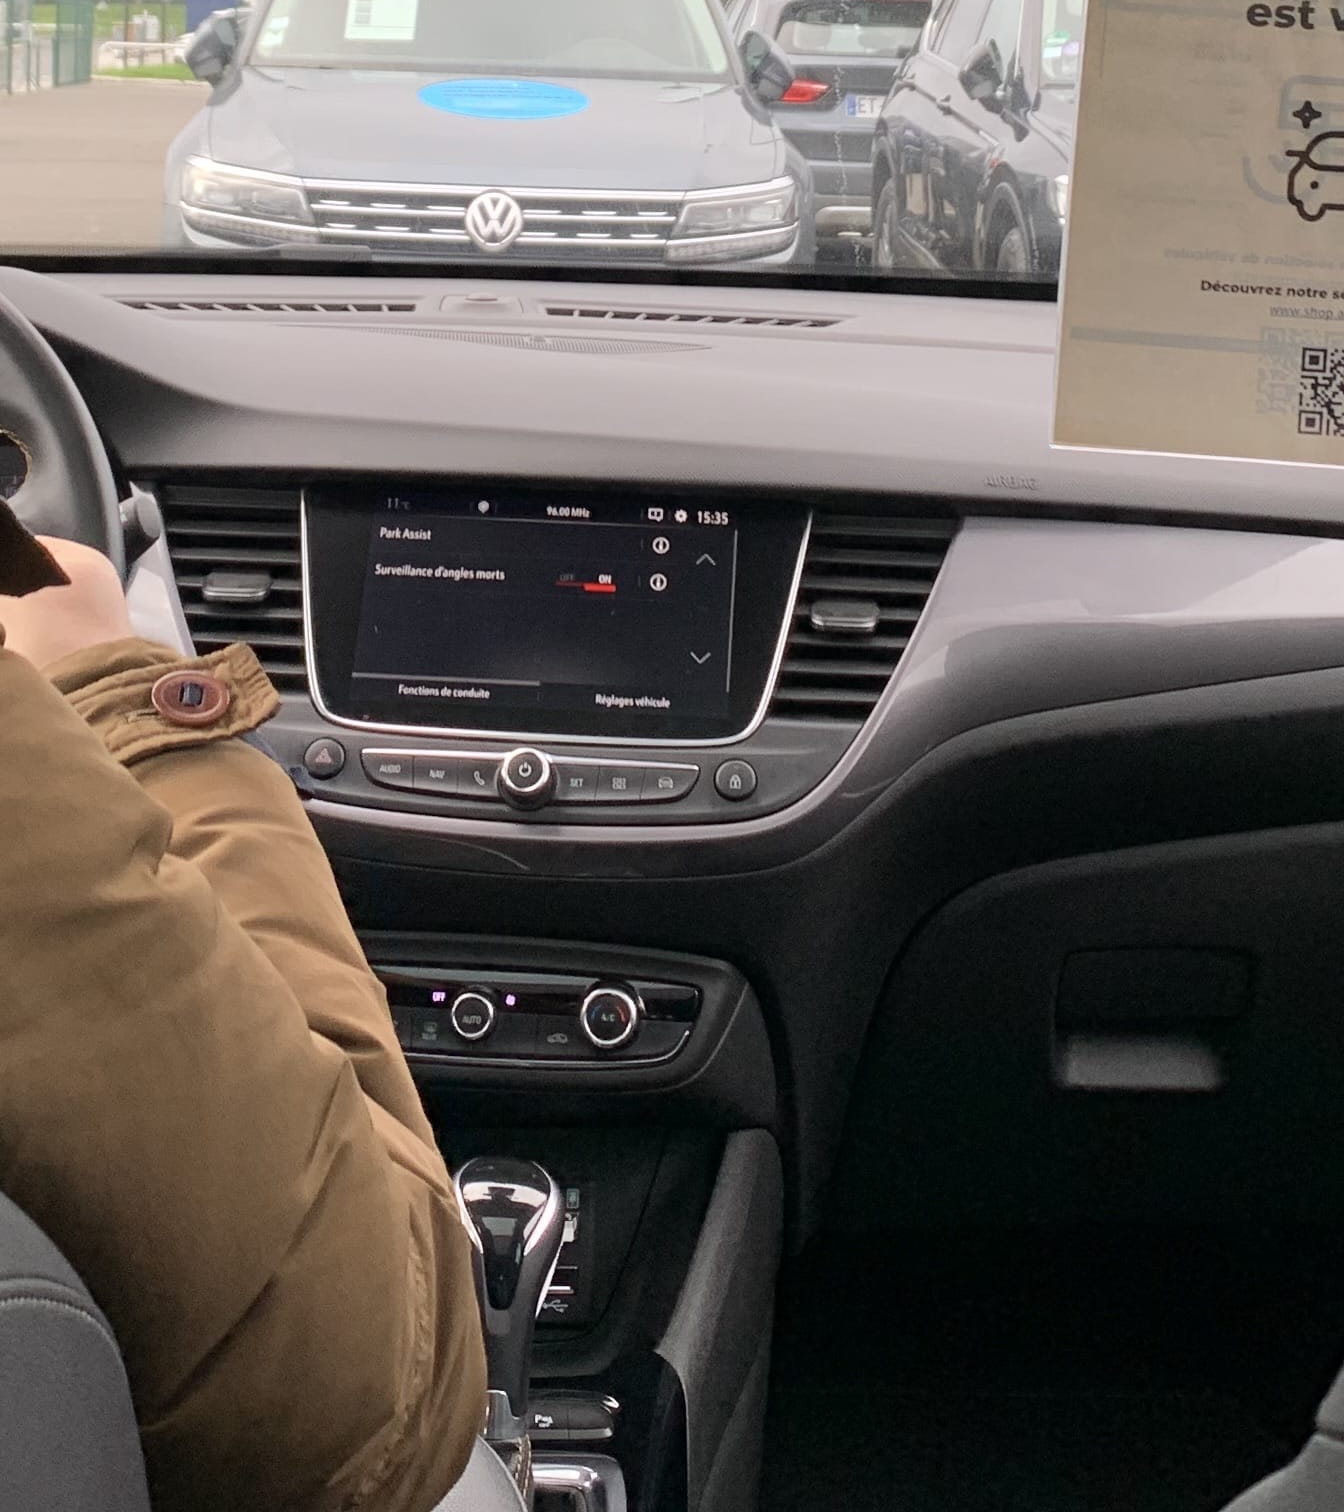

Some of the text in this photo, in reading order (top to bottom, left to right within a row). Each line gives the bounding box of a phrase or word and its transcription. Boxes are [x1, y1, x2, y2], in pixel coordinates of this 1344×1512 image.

[1246, 0, 1315, 30] est
[1200, 279, 1282, 296] Découvrez
[1286, 287, 1327, 300] notre
[546, 506, 590, 518] 96.00 MHz
[697, 510, 729, 526] 15:35
[380, 527, 431, 540] Park Assist
[375, 563, 505, 581] Surveillance d'angles morts
[598, 574, 612, 584] ON
[398, 684, 490, 699] Fonctions de conduite
[595, 693, 670, 709] Réglages véhicule
[379, 763, 402, 774] AUDIO
[429, 768, 446, 780] NAV
[569, 777, 584, 789] SET
[432, 991, 446, 1002] OFF
[462, 1014, 482, 1025] AUTO
[601, 1012, 616, 1023] A/C
